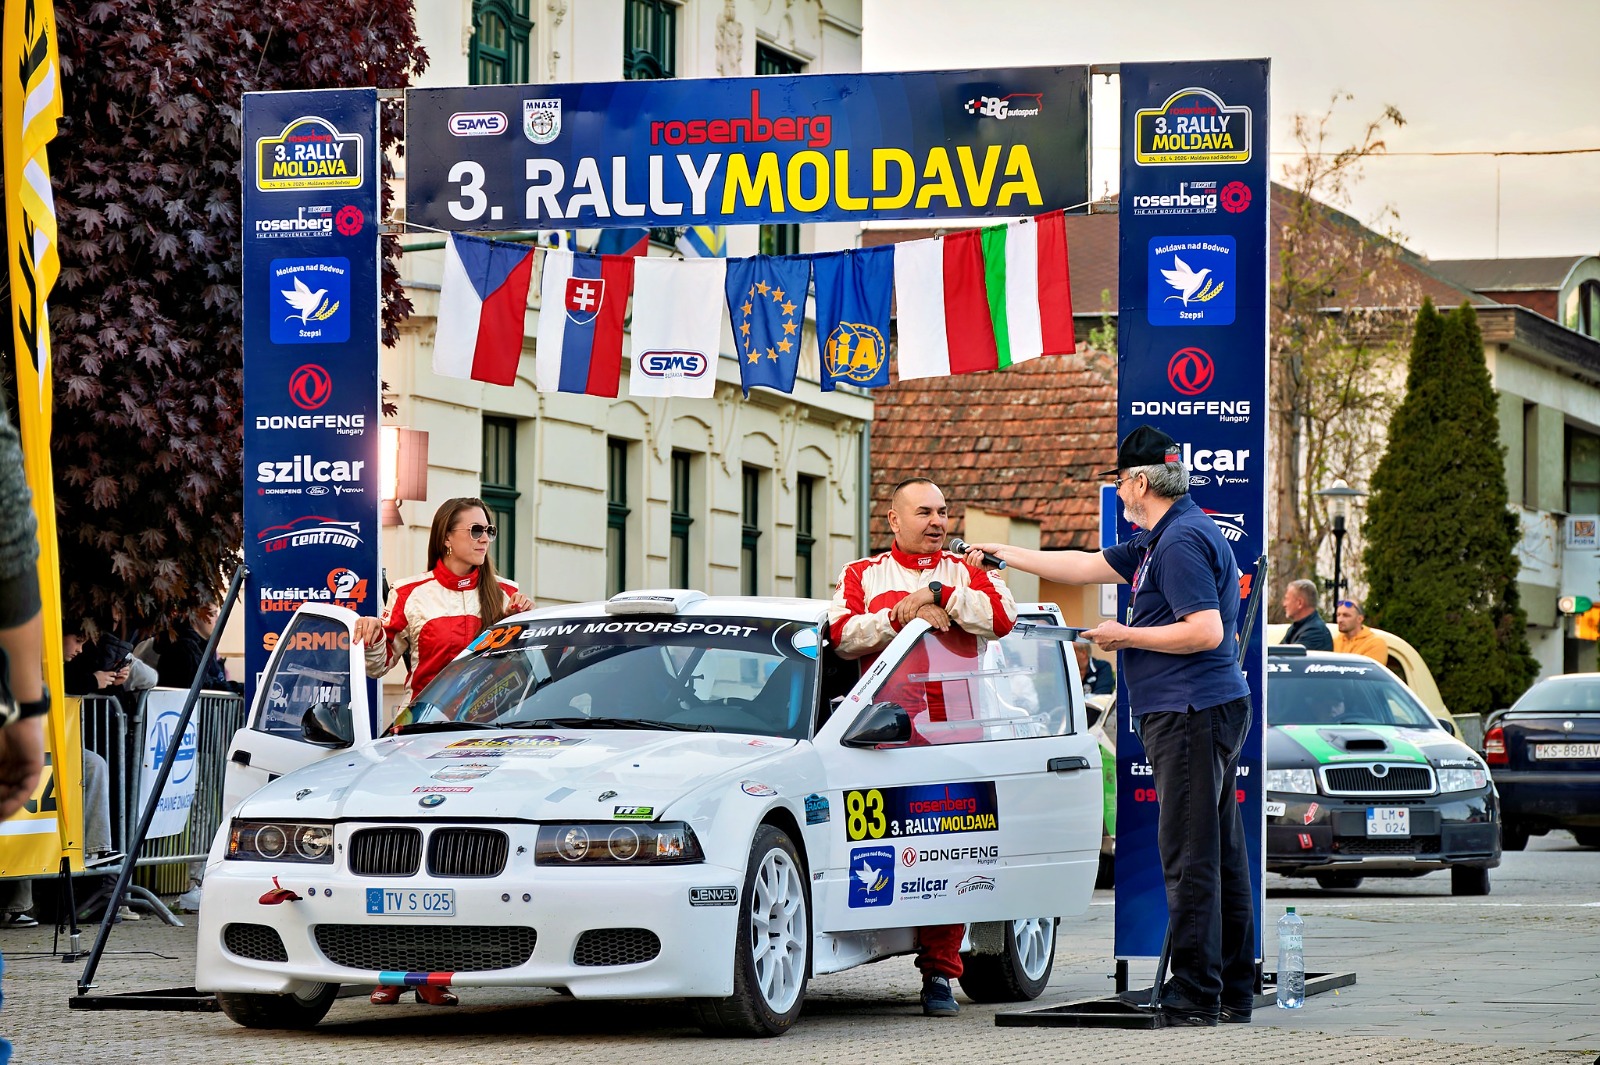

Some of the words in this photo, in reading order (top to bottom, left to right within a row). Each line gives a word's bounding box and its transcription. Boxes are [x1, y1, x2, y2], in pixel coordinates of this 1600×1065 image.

[526, 101, 558, 109] MNASZ
[986, 97, 1009, 119] BG
[1008, 108, 1038, 117] autosport
[1169, 100, 1217, 116] rosenberg
[457, 116, 498, 130] SAMŠ
[650, 88, 832, 148] rosenberg
[1155, 117, 1172, 134] 3.
[1177, 116, 1230, 134] RALLY
[288, 128, 332, 143] rosenberg
[1152, 133, 1234, 150] MOLDAVA
[274, 145, 290, 161] 3.
[294, 143, 344, 160] RALLY
[272, 160, 348, 177] MOLDAVA
[448, 161, 502, 220] 3.
[1134, 182, 1217, 208] rosenberg
[256, 206, 332, 232] rosenberg
[1155, 244, 1186, 255] Moldava
[1202, 243, 1230, 254] Bodvou
[276, 264, 304, 276] Moldava
[320, 264, 345, 275] Bodvou
[1180, 311, 1204, 320] Szepsi
[299, 330, 321, 338] Szepsi
[650, 354, 698, 371] SAMŠ
[1132, 401, 1250, 416] DONGFENG
[256, 415, 364, 429] DONGFENG
[1220, 415, 1250, 423] Hungary
[257, 454, 364, 483] szilcar
[266, 538, 290, 553] car
[292, 532, 358, 549] centrum
[260, 587, 331, 600] Košická
[335, 575, 368, 603] 24
[475, 626, 522, 652] 83
[518, 624, 580, 640] BMW
[584, 622, 758, 638] MOTORSPORT
[909, 786, 976, 814] rosenberg
[847, 789, 886, 841] 83
[1382, 810, 1395, 819] LM
[891, 820, 903, 835] 3.
[1371, 823, 1377, 833] S
[1386, 822, 1406, 833] 024
[920, 846, 998, 862] DONGFENG
[901, 877, 948, 893] szilcar
[958, 887, 967, 895] car
[386, 893, 402, 910] TV
[409, 893, 417, 910] S
[423, 894, 450, 910] 025
[691, 890, 736, 900] JENVEY
